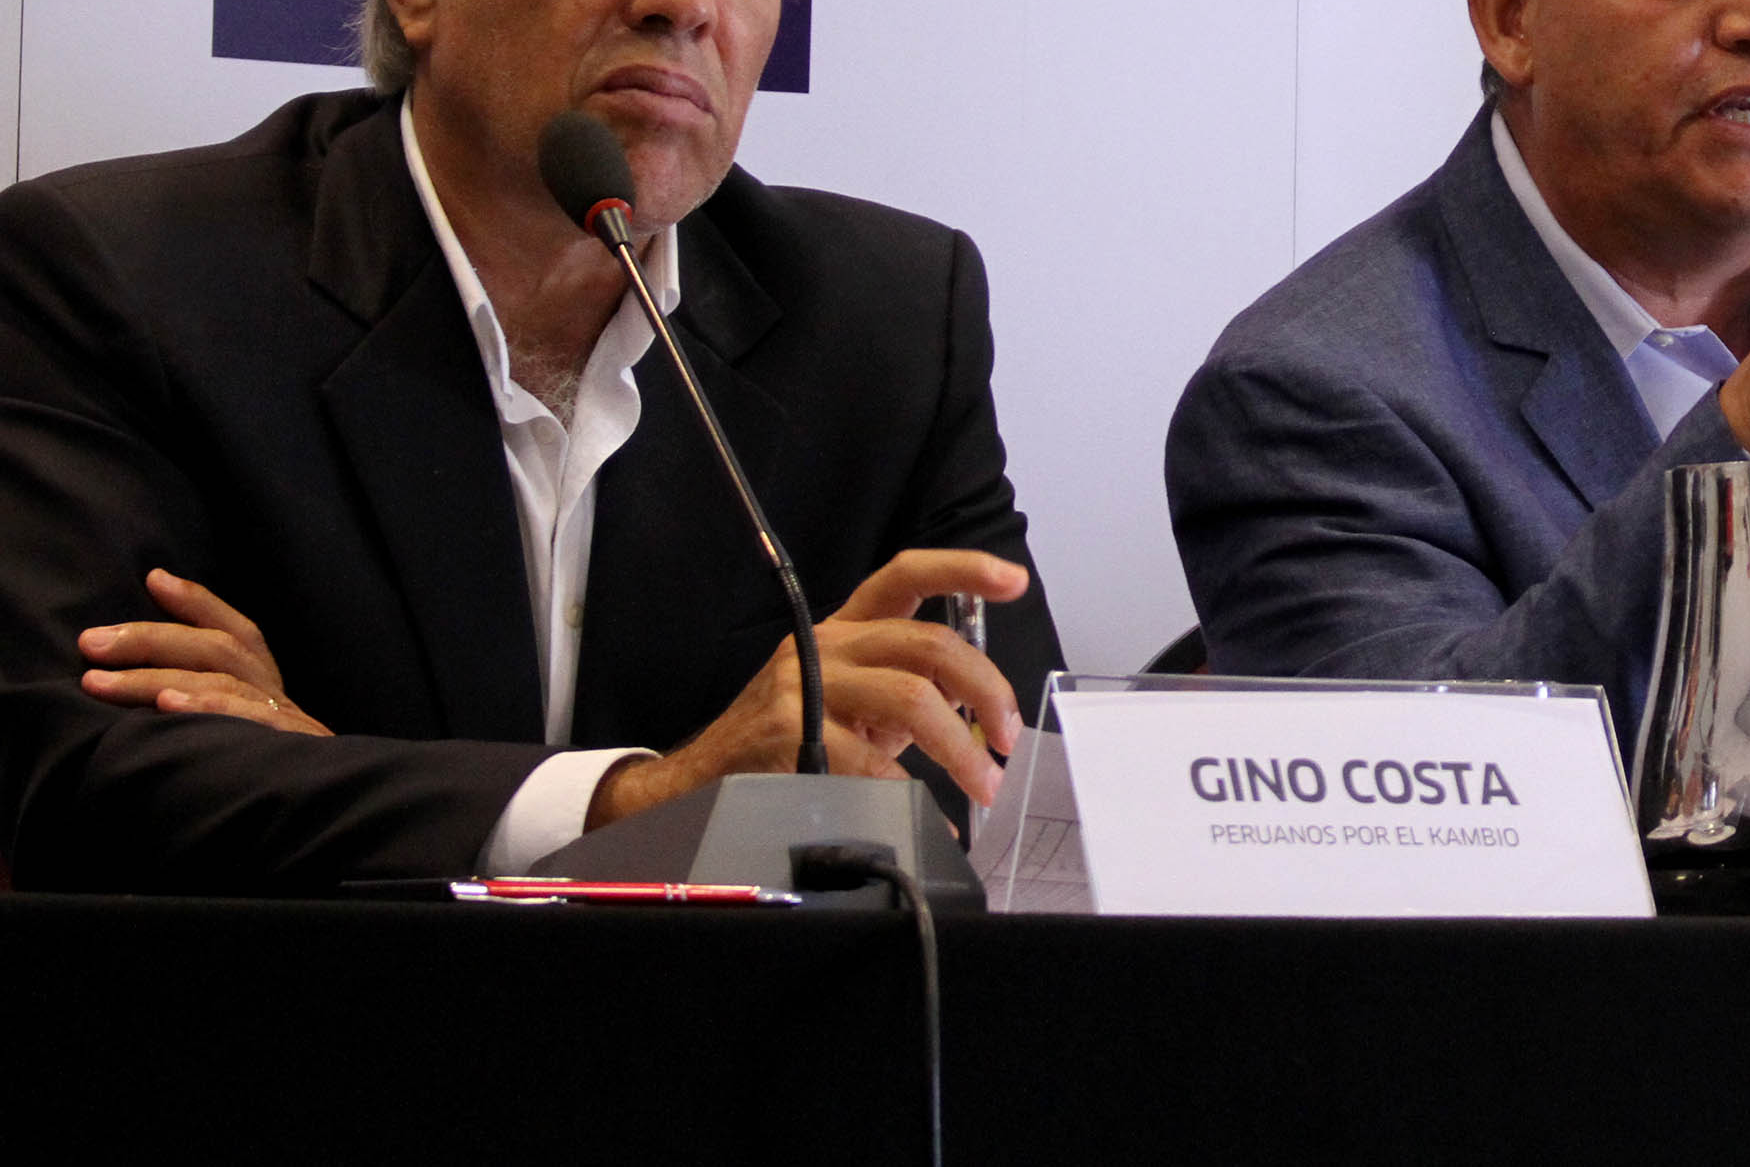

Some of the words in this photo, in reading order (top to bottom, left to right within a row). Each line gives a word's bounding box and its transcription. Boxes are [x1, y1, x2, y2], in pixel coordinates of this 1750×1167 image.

[1190, 756, 1328, 804] GINO
[1341, 759, 1521, 806] COSTA
[1210, 823, 1337, 846] PERUANOS
[1343, 825, 1391, 846] POR
[1397, 825, 1424, 846] EL
[1428, 826, 1520, 848] KAMBIO
